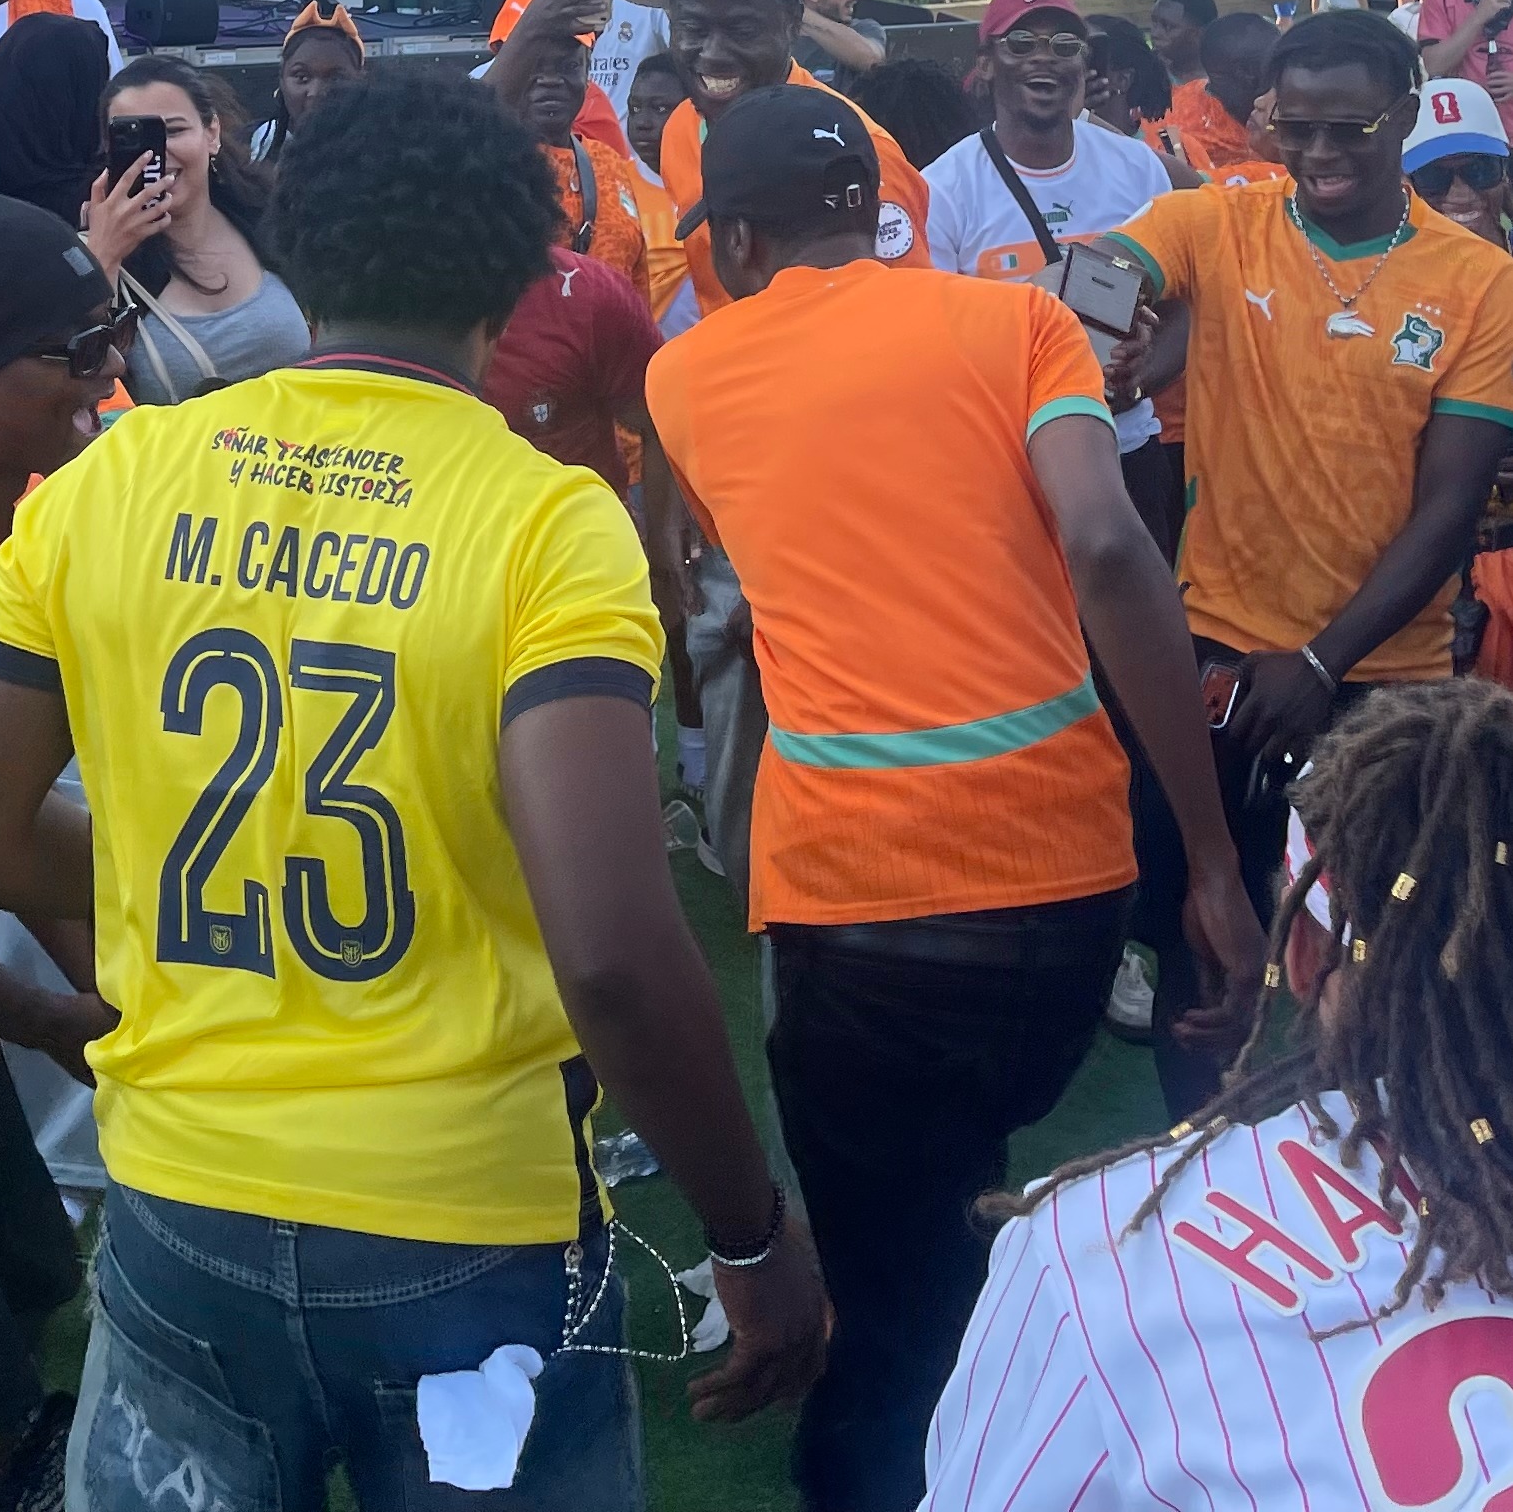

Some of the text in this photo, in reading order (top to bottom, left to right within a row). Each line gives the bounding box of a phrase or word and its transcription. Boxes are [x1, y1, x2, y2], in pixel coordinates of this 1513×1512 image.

[250, 462, 314, 495] HACER
[164, 512, 222, 586] M.
[156, 627, 416, 982] 23
[1173, 1138, 1420, 1309] HA
